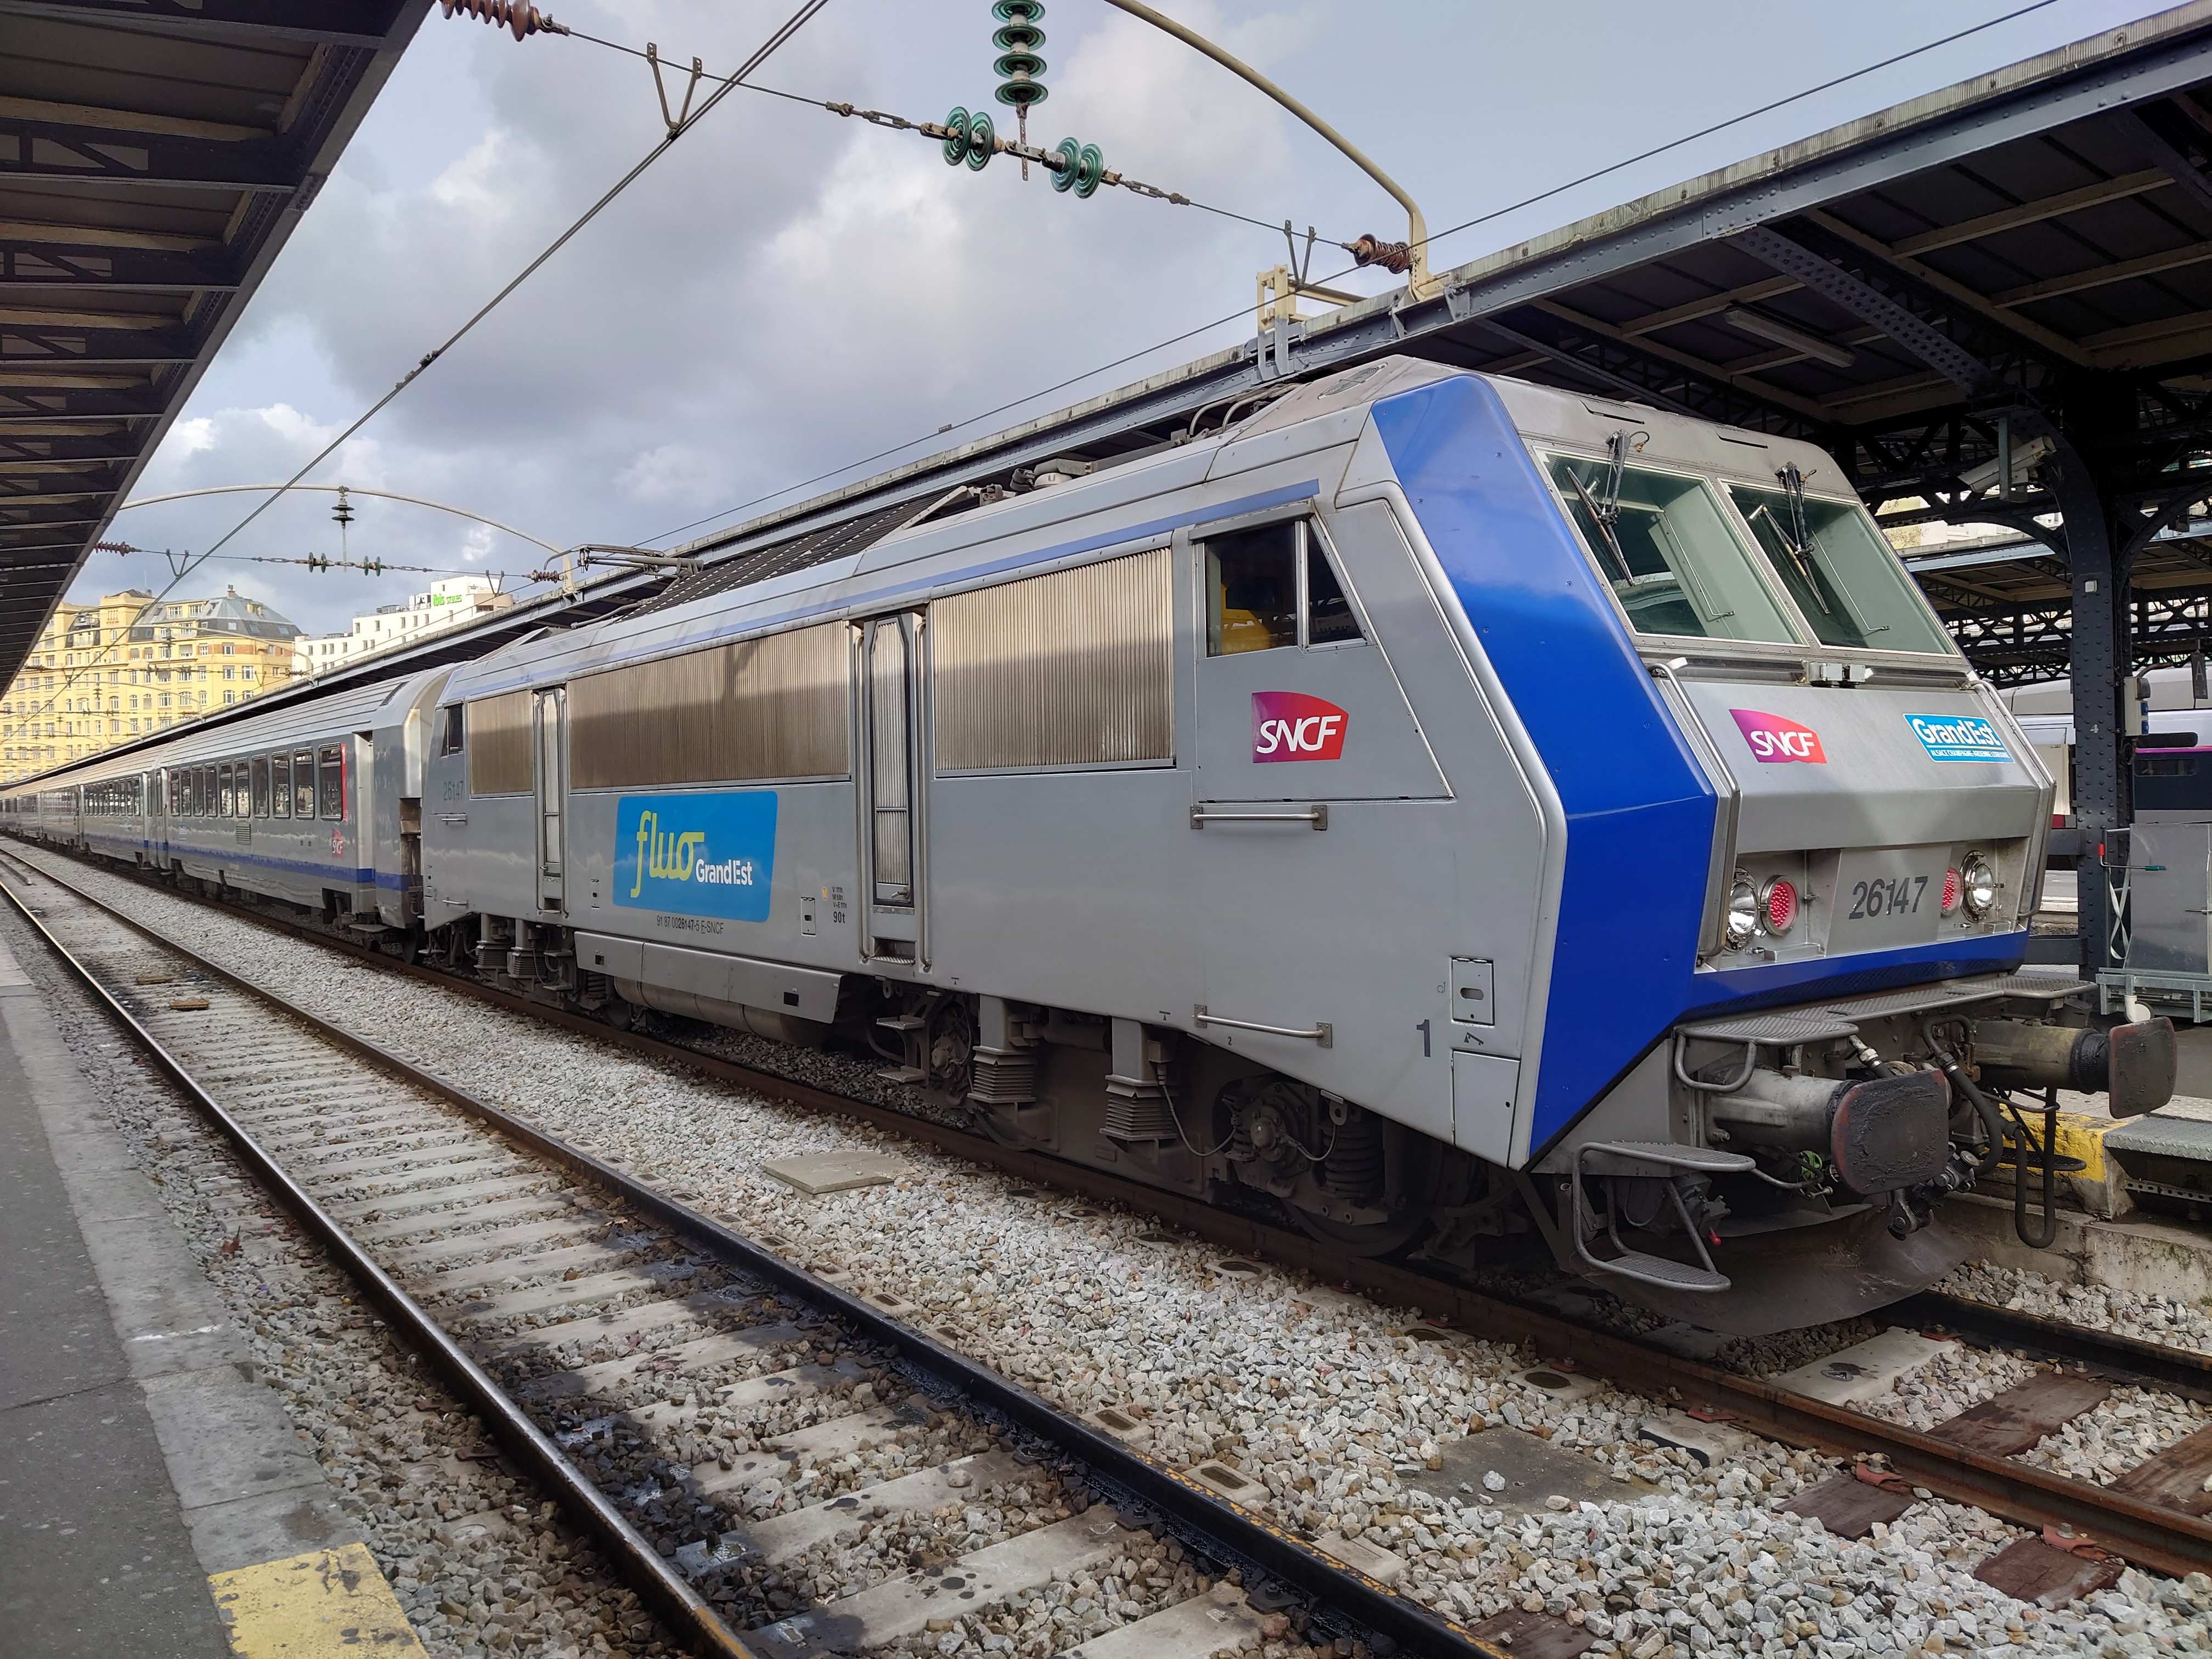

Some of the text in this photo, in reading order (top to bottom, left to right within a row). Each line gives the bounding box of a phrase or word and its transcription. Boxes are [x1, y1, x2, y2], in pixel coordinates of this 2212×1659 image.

[2196, 661, 2204, 680] A
[1256, 715, 1341, 754] SNCF
[2090, 724, 2099, 733] 4
[1750, 731, 1815, 757] SNCF
[443, 781, 464, 801] 26147
[630, 810, 704, 898] fluo
[1849, 876, 1928, 920] 26147
[657, 915, 724, 934] 91 87 0026147-5 F-SNCF
[833, 911, 845, 923] 90t
[1228, 1036, 1232, 1046] 2
[1416, 1019, 1431, 1058] 1
